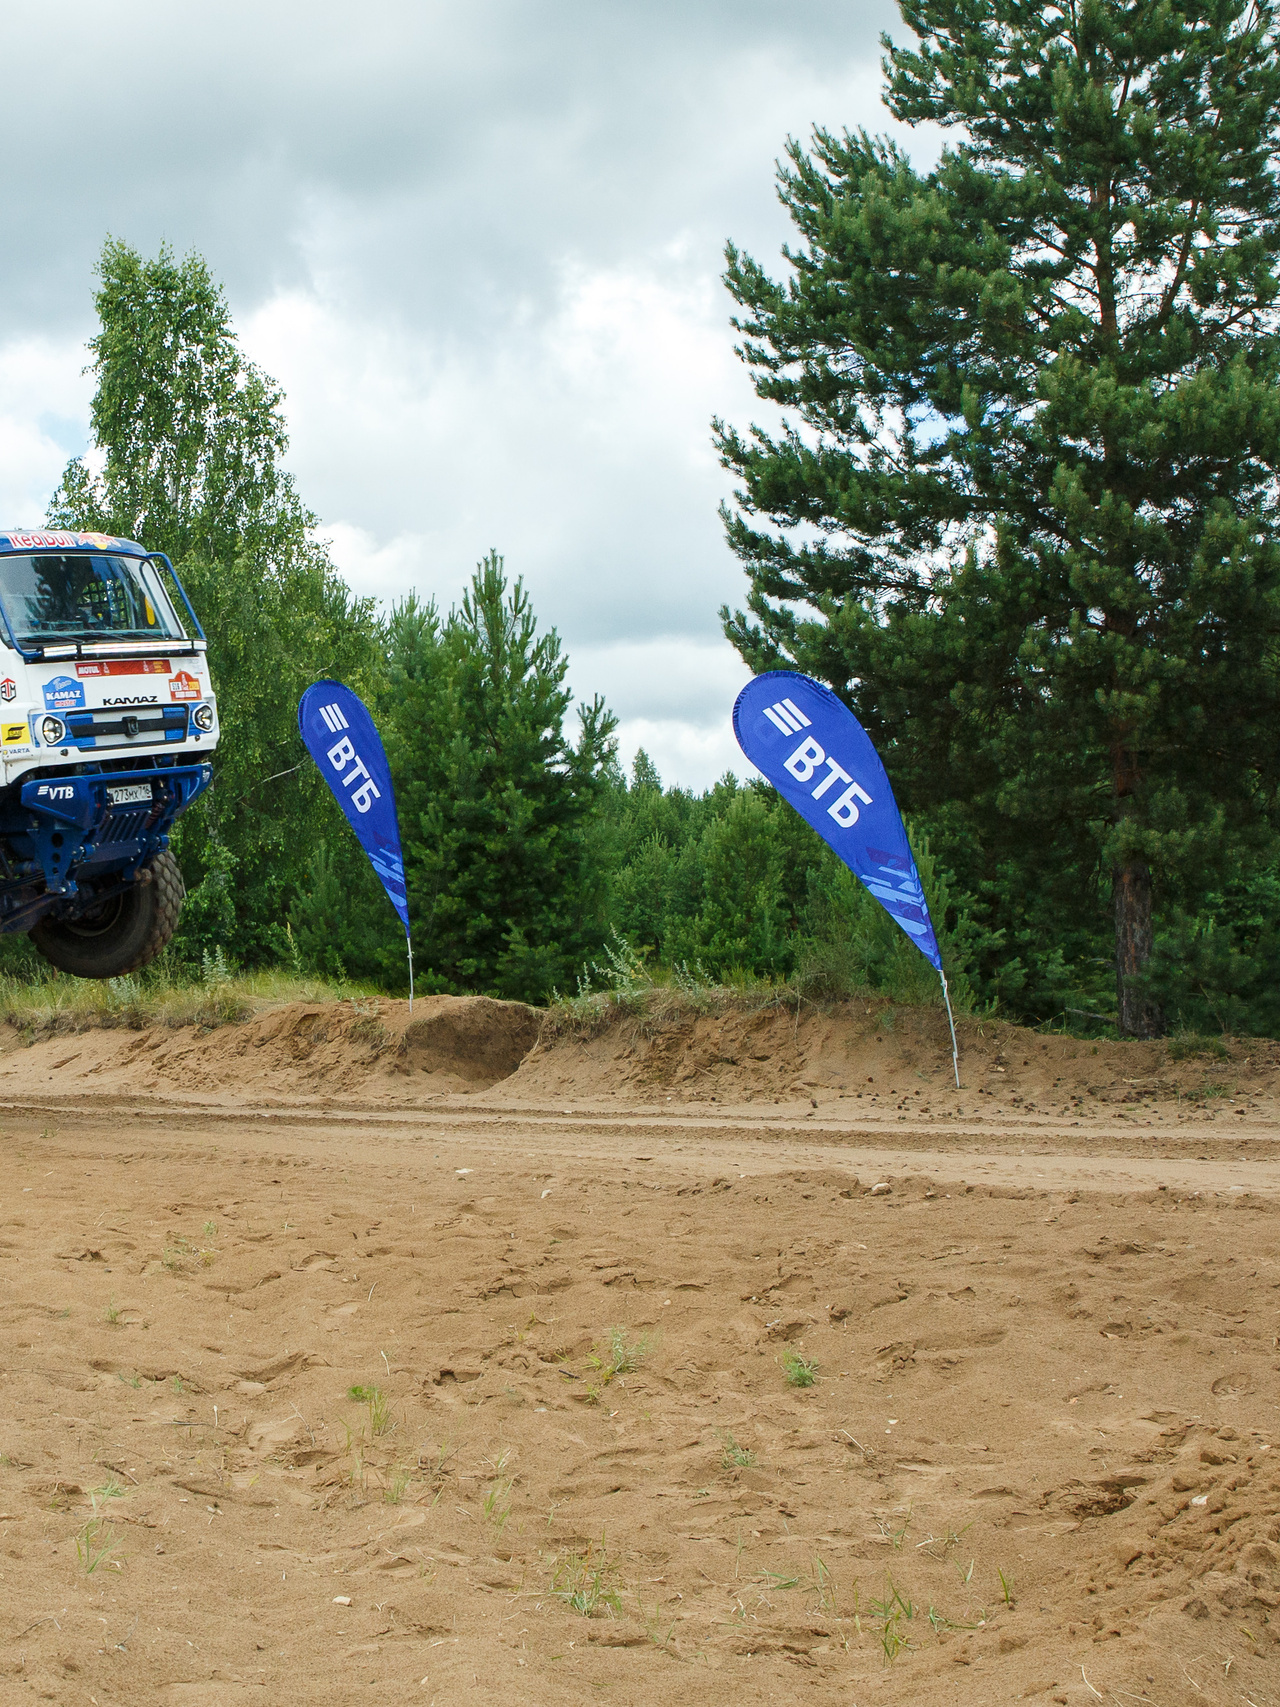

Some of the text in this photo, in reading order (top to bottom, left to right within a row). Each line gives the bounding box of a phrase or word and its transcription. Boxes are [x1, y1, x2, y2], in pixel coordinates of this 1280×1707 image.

[8, 532, 76, 548] Red Bull
[78, 666, 100, 675] MOTUL
[46, 690, 81, 700] KAMAZ
[103, 696, 158, 706] KAMAZ
[55, 699, 76, 707] master
[327, 735, 382, 814] ВТБ
[783, 735, 873, 828] ВТБ
[49, 786, 74, 800] VTB
